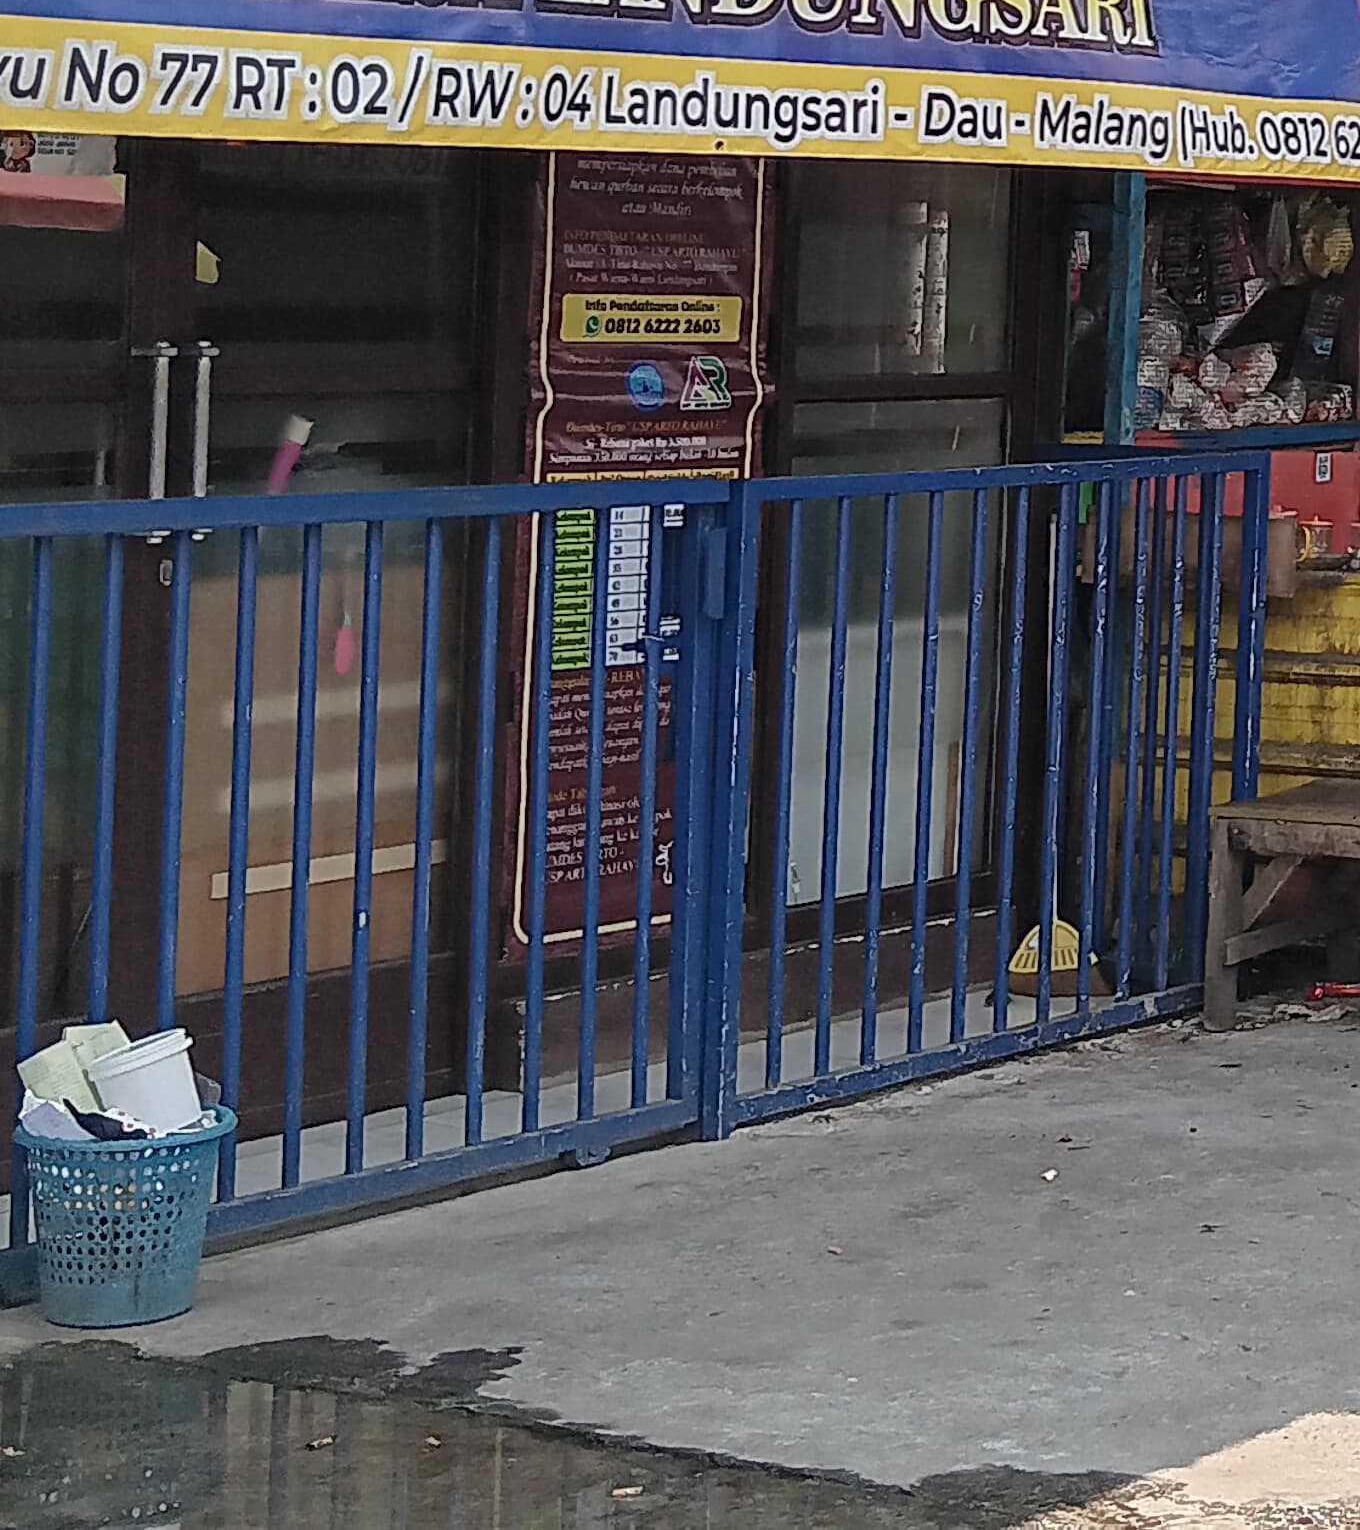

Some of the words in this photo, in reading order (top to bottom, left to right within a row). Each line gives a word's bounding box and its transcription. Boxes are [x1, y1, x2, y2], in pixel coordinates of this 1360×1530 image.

[64, 46, 140, 104] No
[159, 52, 219, 112] 77
[603, 73, 881, 149] Landungsari
[924, 95, 1002, 144] Dau
[1040, 98, 1170, 160] Malang
[1259, 114, 1327, 161] 0812
[605, 318, 641, 334] 0812
[644, 318, 681, 334] 6222
[684, 318, 721, 334] 2603
